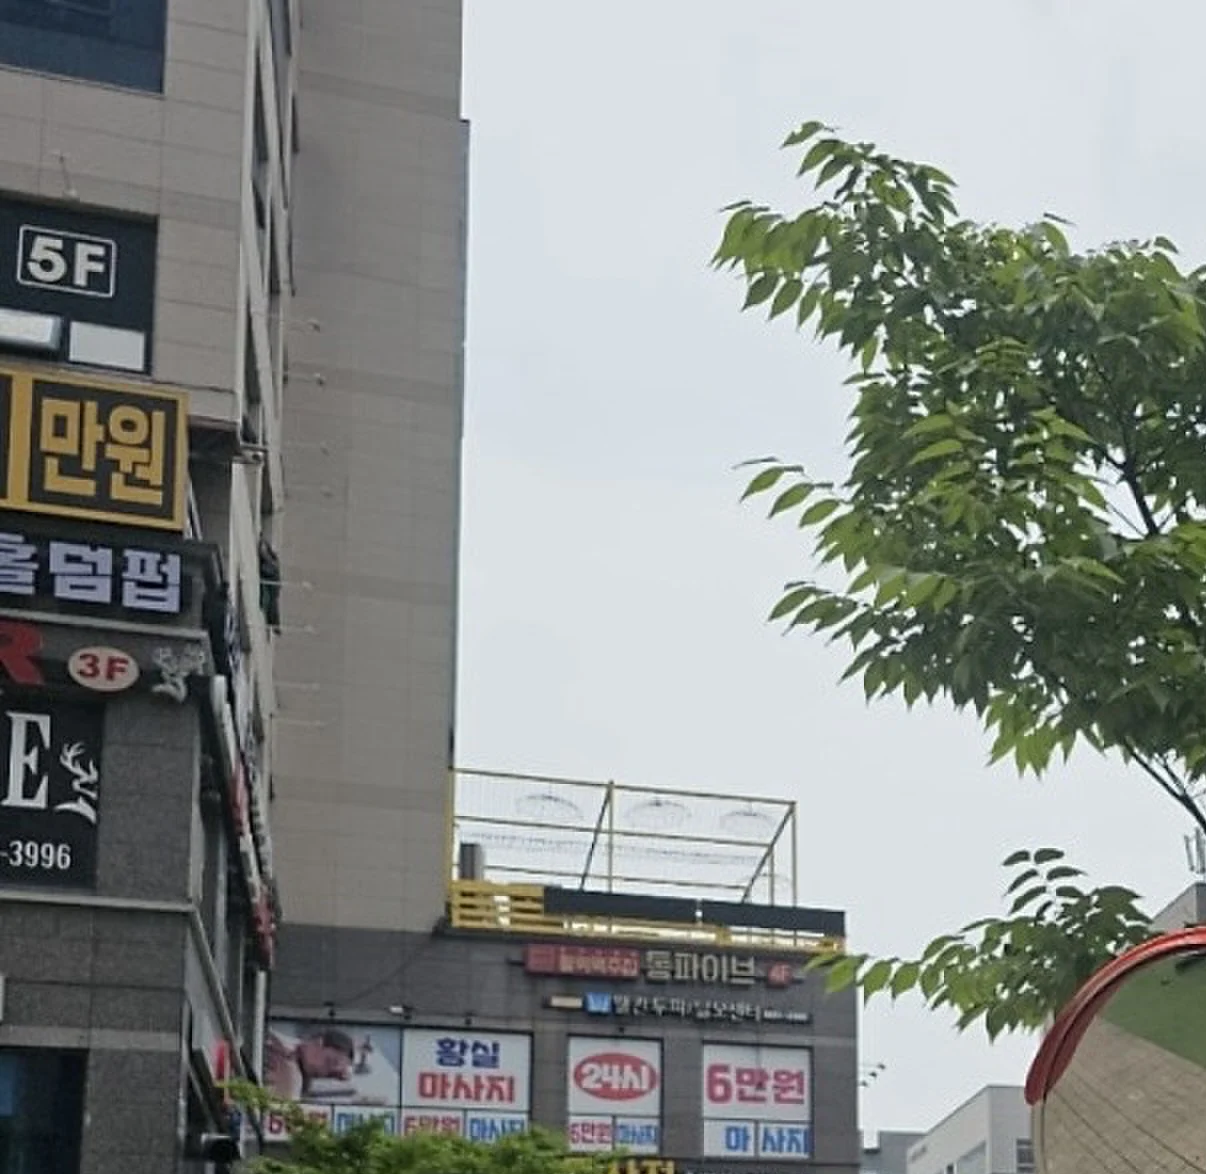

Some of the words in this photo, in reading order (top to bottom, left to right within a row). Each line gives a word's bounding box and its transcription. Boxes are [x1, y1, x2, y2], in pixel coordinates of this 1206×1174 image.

[27, 236, 107, 288] 5F
[40, 399, 165, 506] 만원
[77, 653, 129, 682] 3F
[5, 711, 51, 809] E
[0, 839, 72, 870] -3996
[437, 1036, 500, 1069] 황실
[418, 1071, 515, 1103] 마사지
[580, 1062, 650, 1091] 24시
[706, 1064, 805, 1105] 6만원
